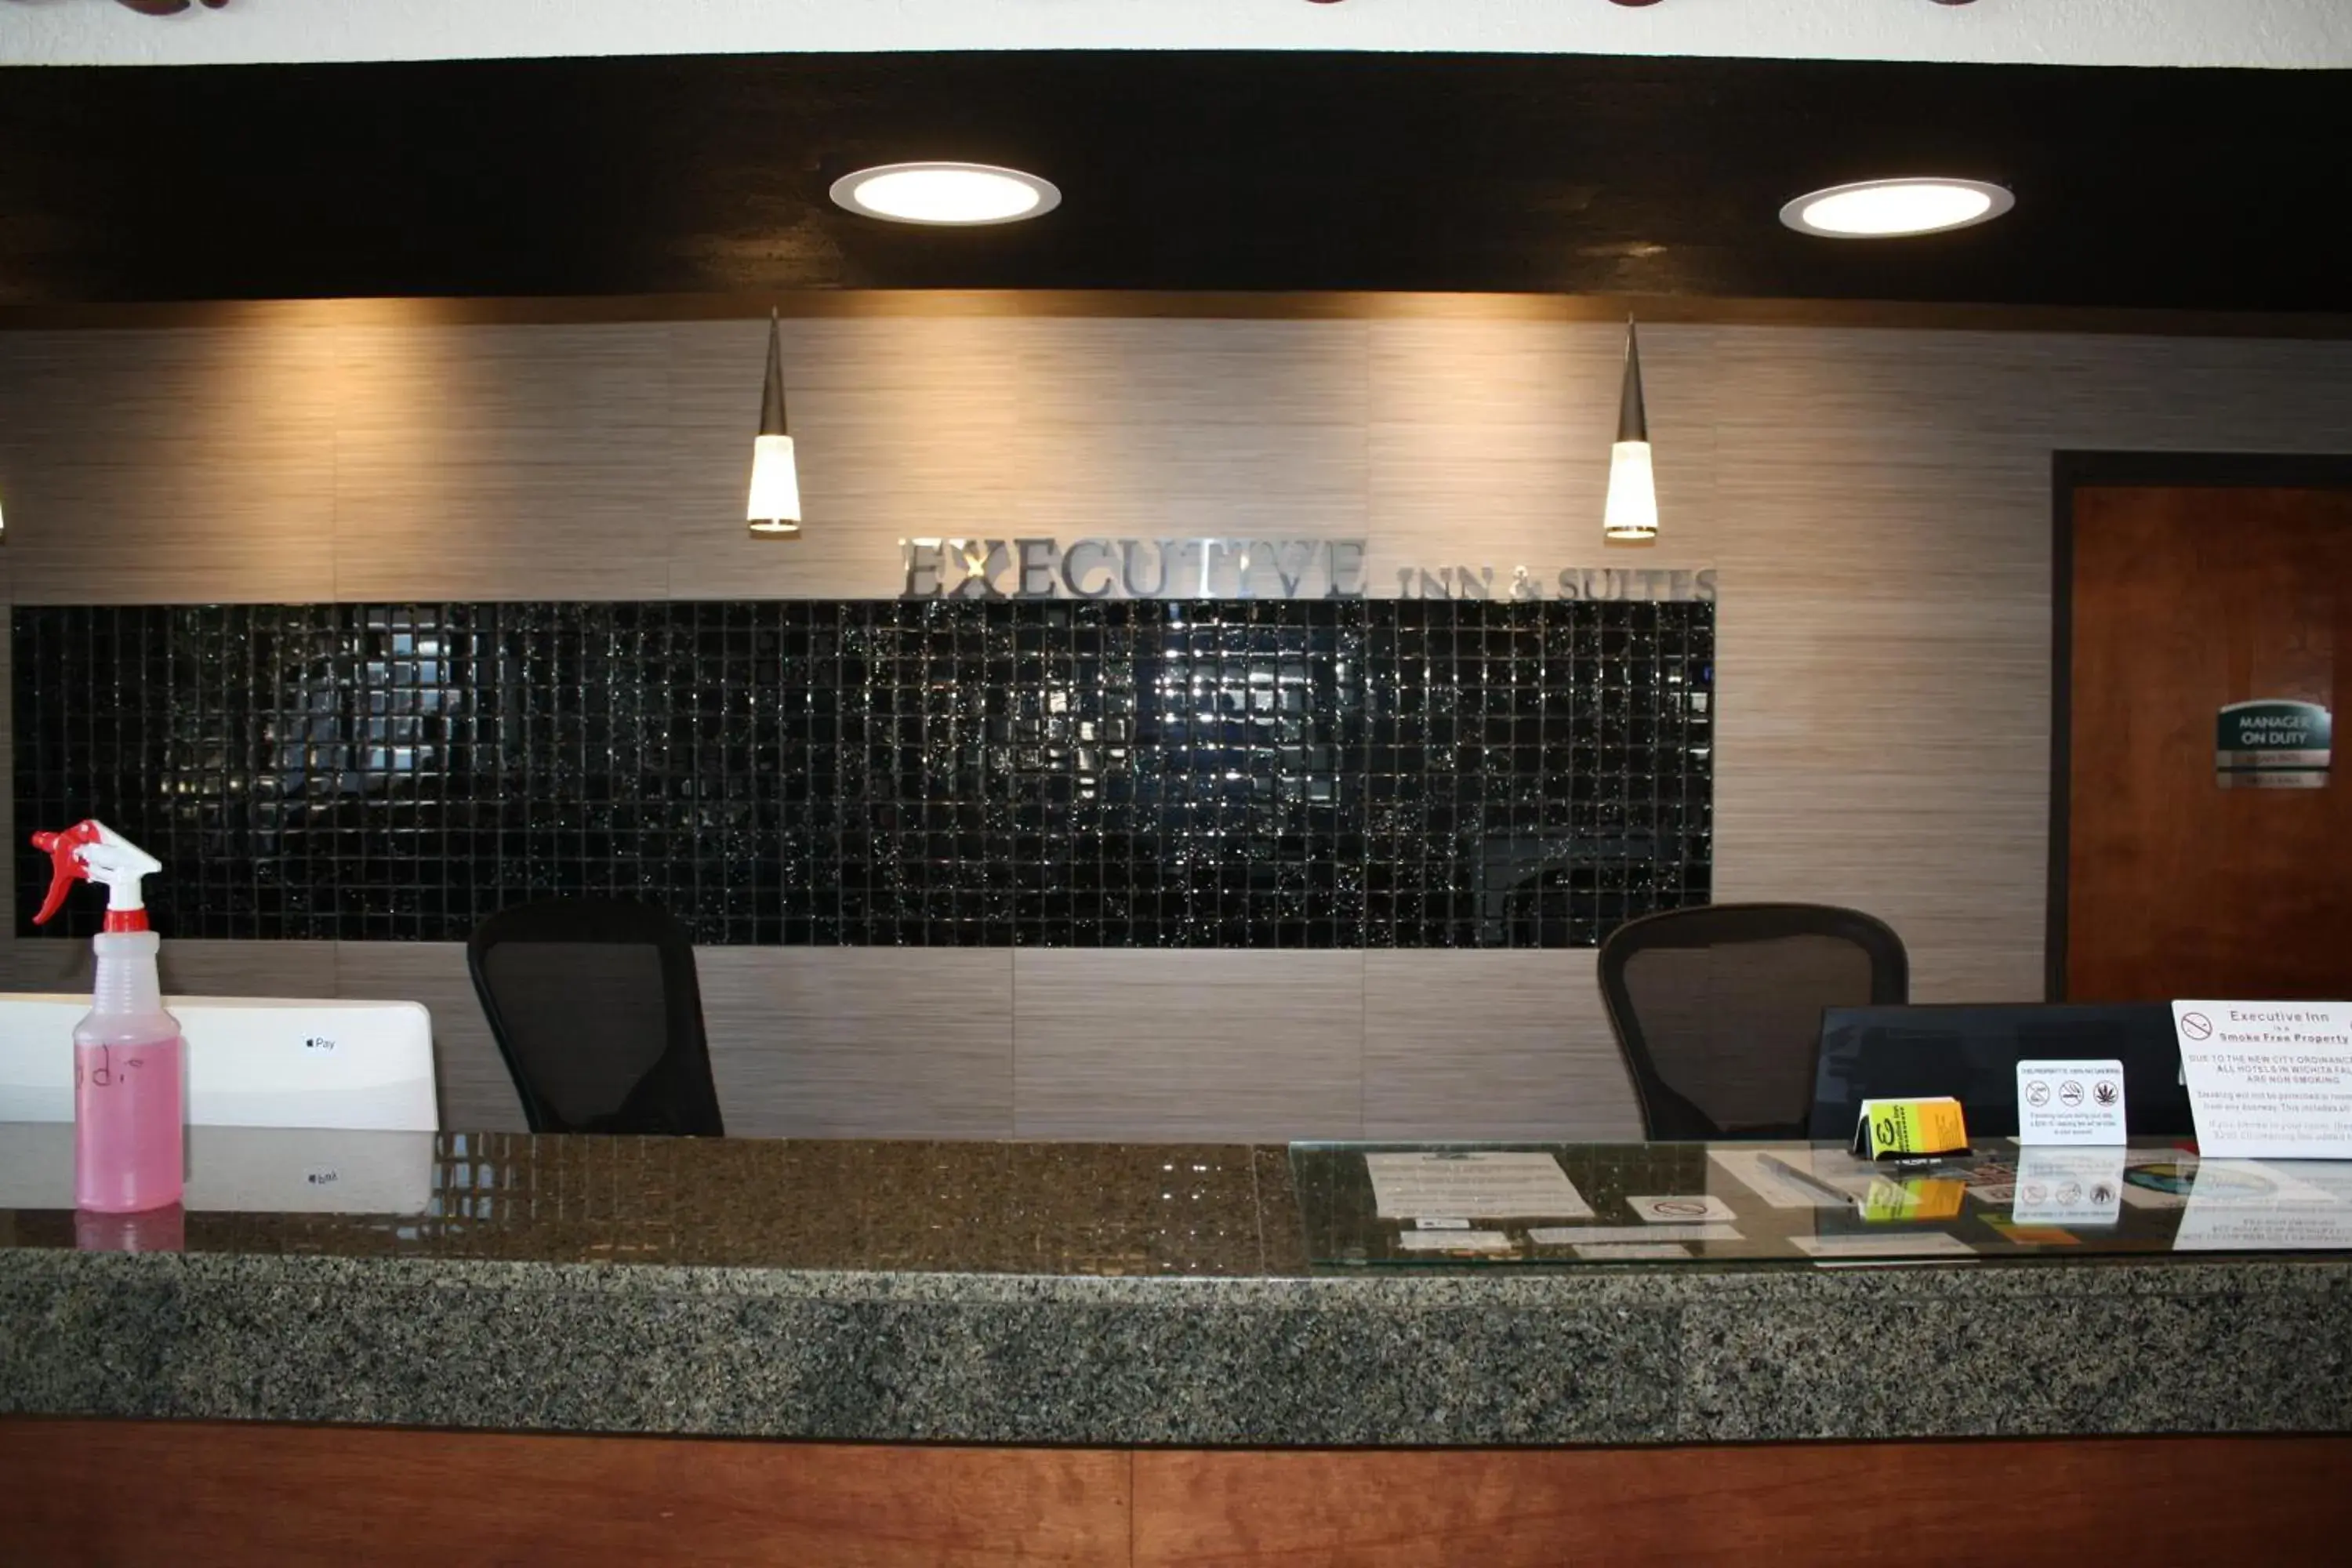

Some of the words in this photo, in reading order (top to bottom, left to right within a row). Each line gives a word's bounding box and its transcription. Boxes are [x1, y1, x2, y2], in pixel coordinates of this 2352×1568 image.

[898, 537, 1367, 600] EXECUTIVE
[1396, 565, 1493, 600] INN
[1508, 564, 1541, 600] &
[1557, 567, 1718, 601] SUITES
[2239, 715, 2311, 728] MANAGER
[2241, 731, 2266, 745] ON
[2269, 731, 2307, 745] DUTY
[2230, 1010, 2302, 1022] Executive
[2304, 1011, 2330, 1022] Inn
[316, 1036, 336, 1051] Pay
[2219, 1032, 2260, 1043] Smoke
[2263, 1033, 2291, 1043] Free
[2293, 1033, 2349, 1044] Property
[2247, 1075, 2267, 1083] ARE
[2293, 1076, 2340, 1084] SMOKING
